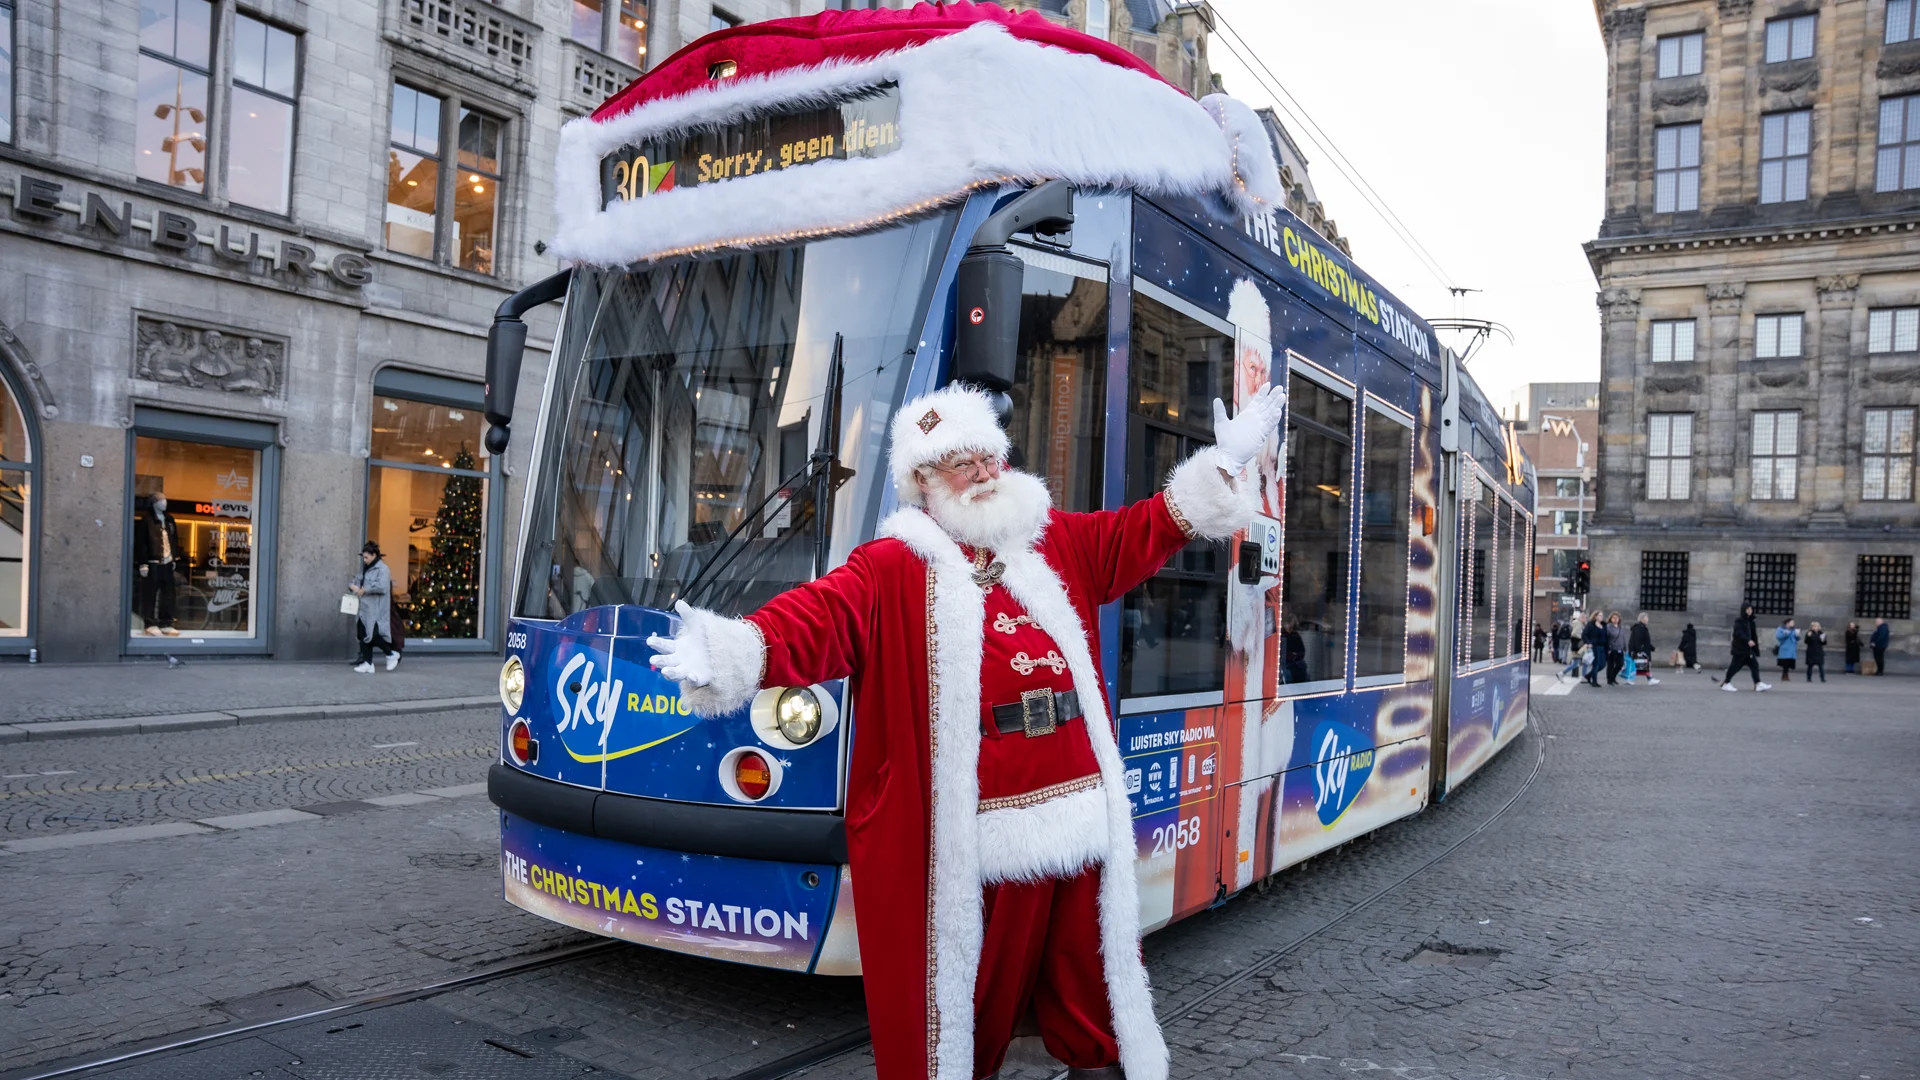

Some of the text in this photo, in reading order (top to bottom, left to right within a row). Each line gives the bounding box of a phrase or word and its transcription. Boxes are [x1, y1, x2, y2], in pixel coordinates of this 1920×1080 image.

[612, 156, 649, 202] 30
[698, 120, 901, 182] Sorry, geen dien
[14, 174, 373, 287] ENBURG
[1244, 212, 1431, 362] THE CHRISTMAS STATION
[215, 588, 240, 603] NIKE
[507, 632, 527, 650] 2058
[556, 652, 693, 746] Sky RADIO
[1131, 725, 1215, 751] LUISTER SKY RADIO VIA
[1315, 728, 1373, 812] Sky RADIO
[1151, 815, 1201, 859] 2058
[505, 849, 808, 940] THE CHRISTMAS STATION
